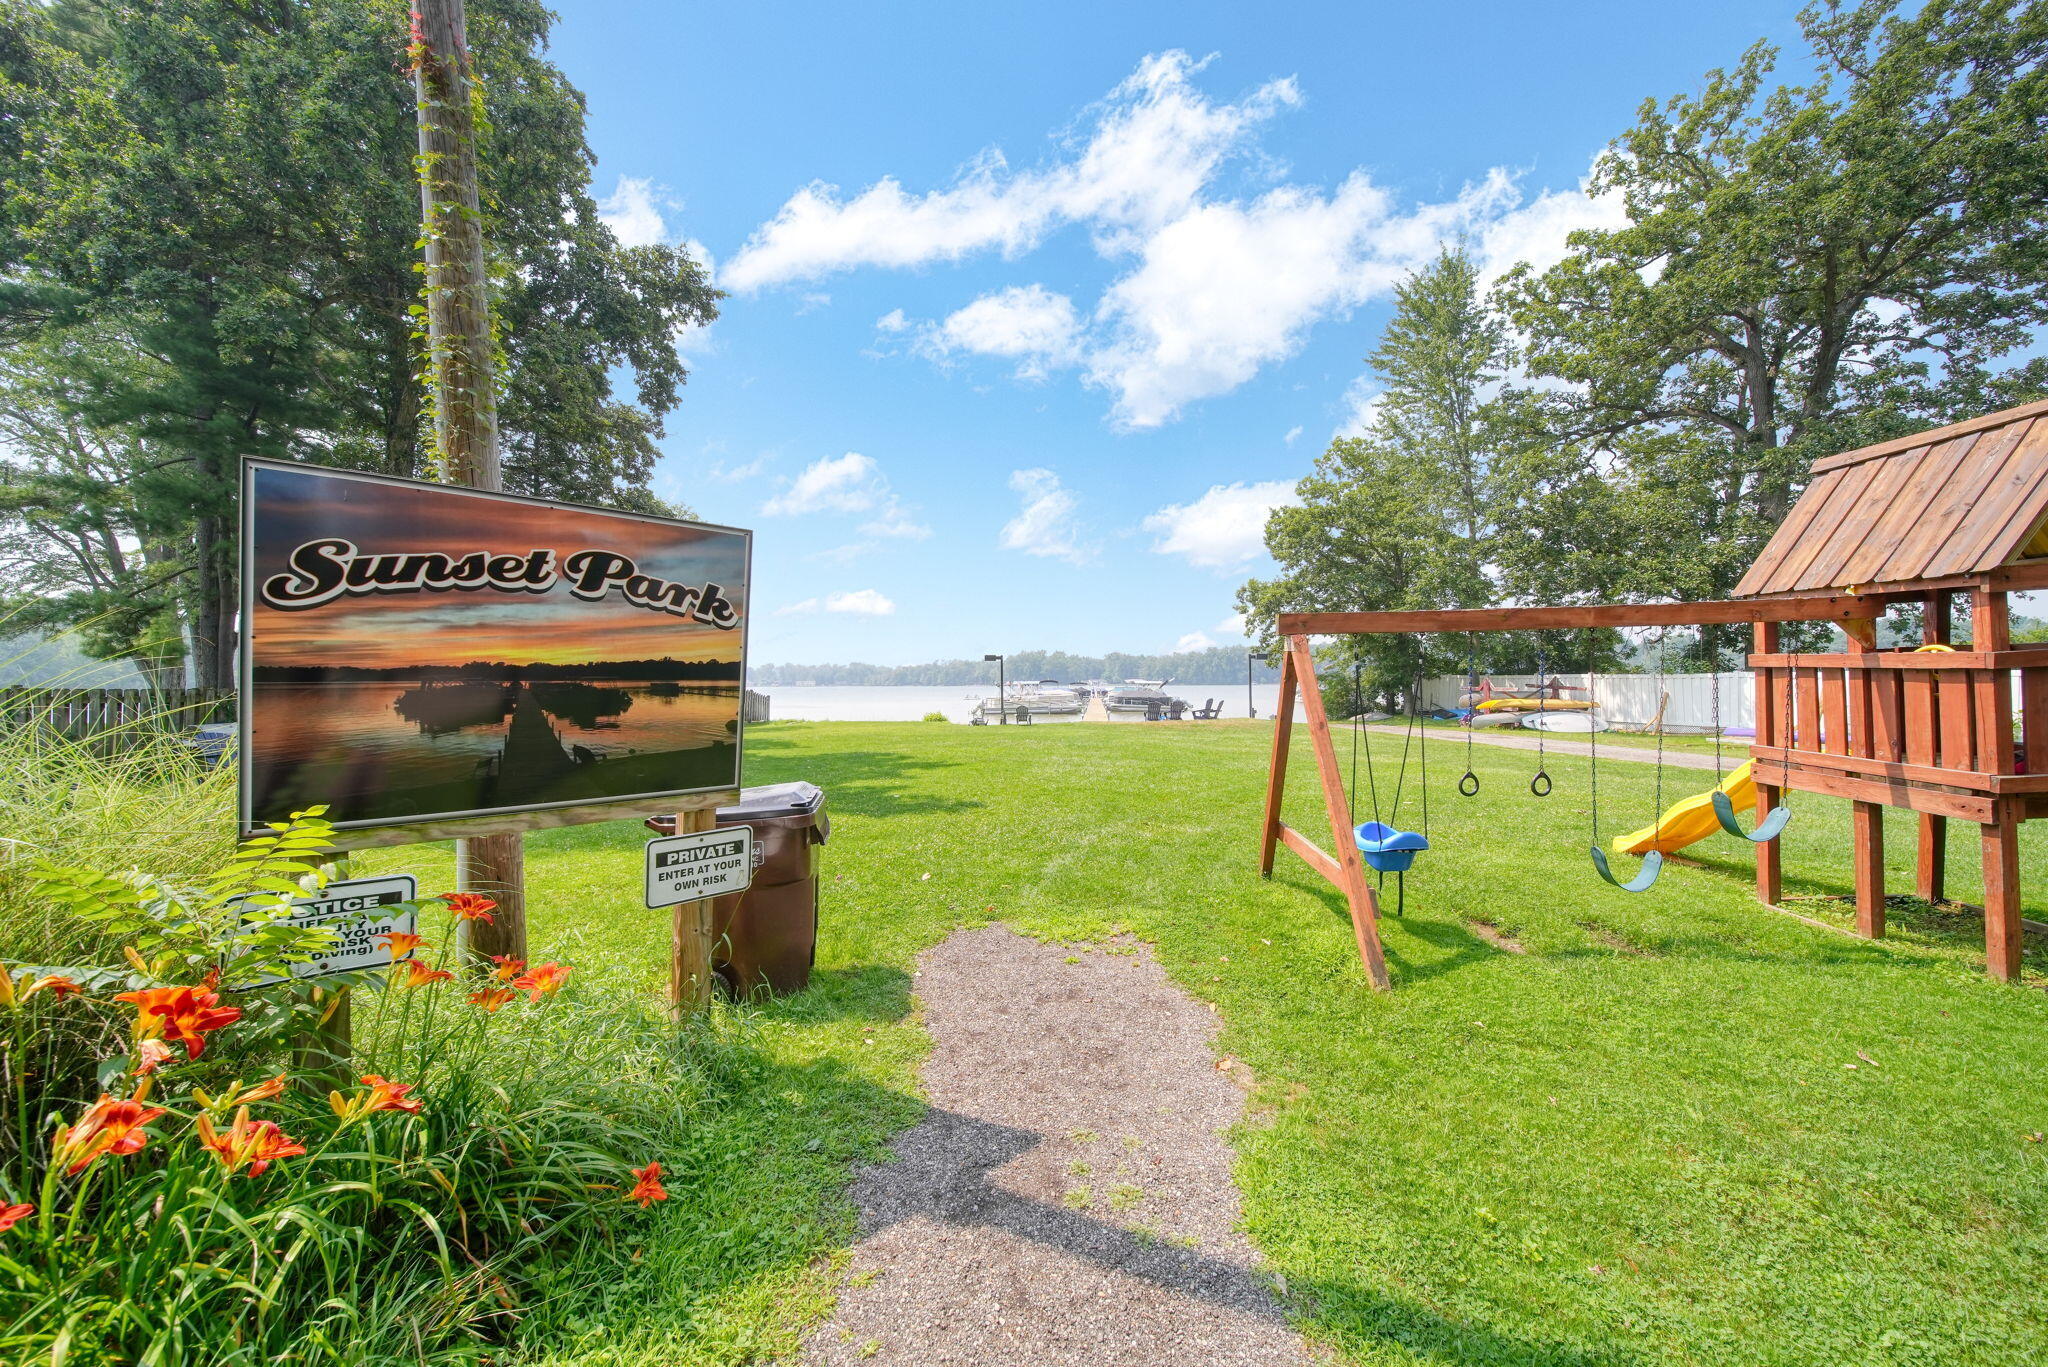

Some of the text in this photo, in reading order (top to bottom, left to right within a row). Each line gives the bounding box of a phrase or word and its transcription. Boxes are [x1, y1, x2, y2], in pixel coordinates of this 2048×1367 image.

[261, 537, 739, 630] Sunset Park
[667, 843, 735, 865] PRIVATE
[658, 867, 694, 882] ENTER
[697, 864, 710, 874] AT
[713, 859, 742, 871] YOUR
[674, 873, 727, 891] OWN RISK
[284, 896, 380, 919] OTICE
[341, 925, 392, 939] YOUR
